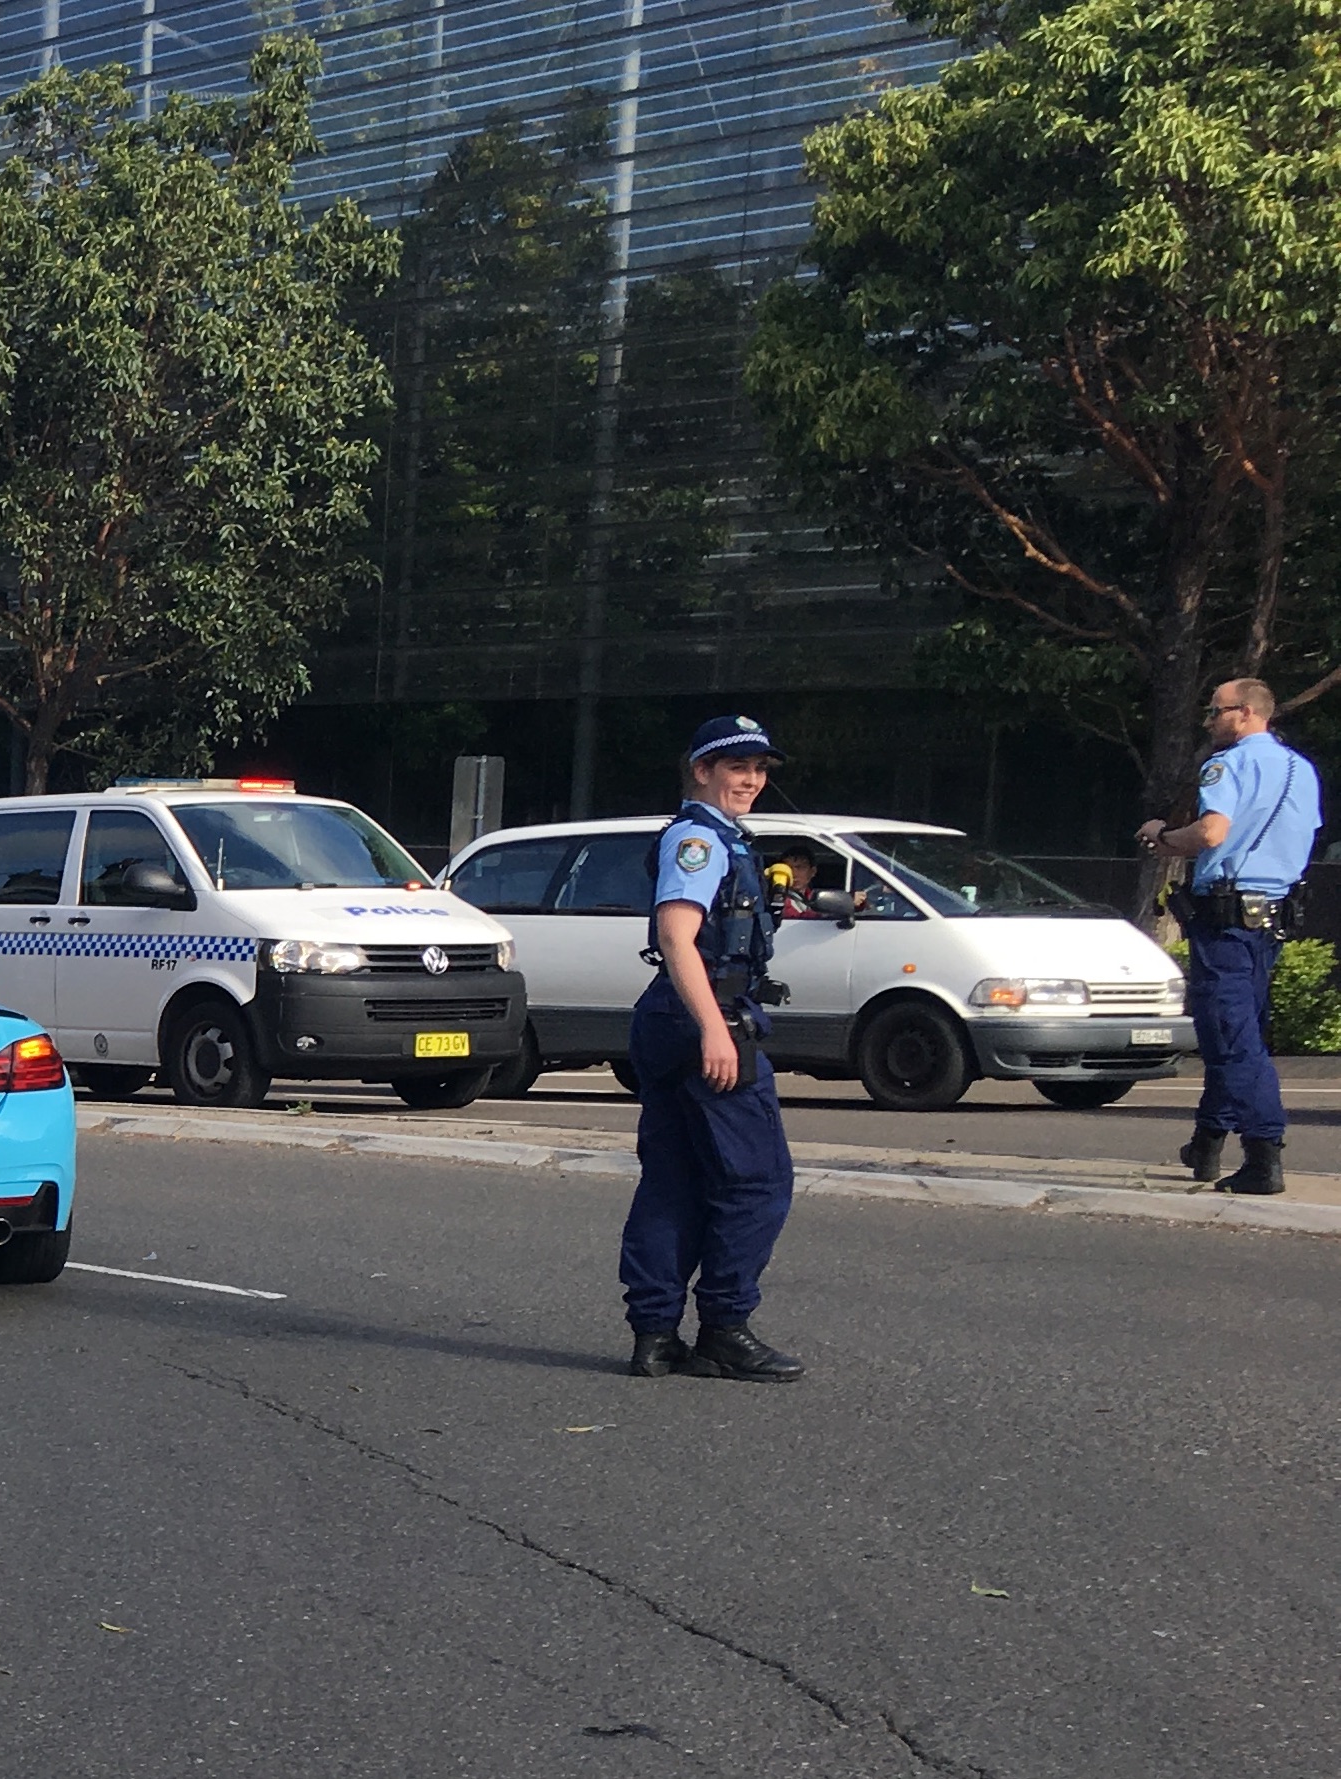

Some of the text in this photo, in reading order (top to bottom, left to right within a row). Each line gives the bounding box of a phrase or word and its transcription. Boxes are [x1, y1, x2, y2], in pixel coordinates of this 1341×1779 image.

[343, 905, 450, 916] Police
[151, 958, 178, 971] RF17
[418, 1036, 432, 1051] CE
[436, 1036, 450, 1051] 73
